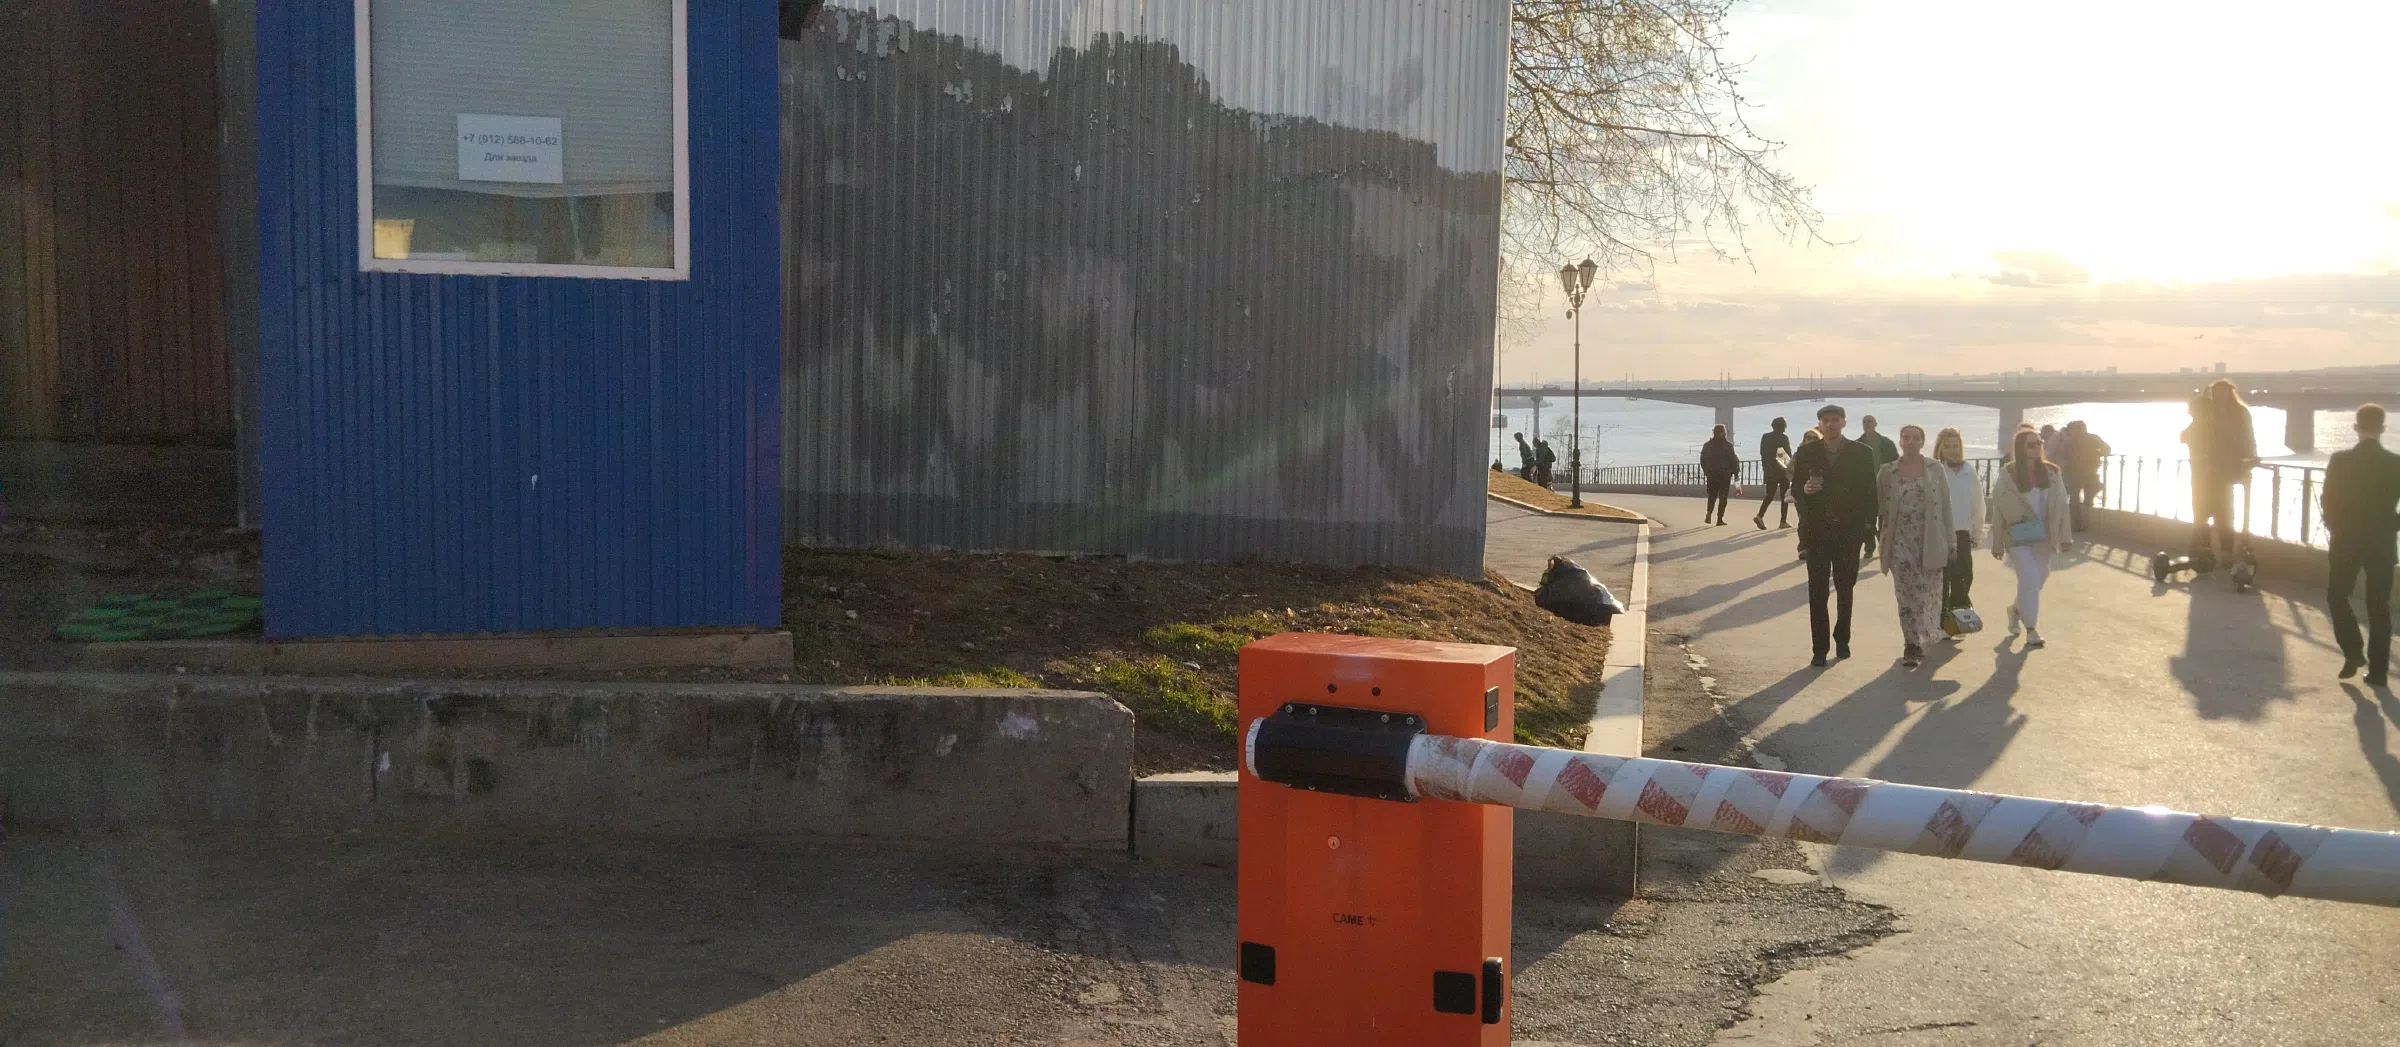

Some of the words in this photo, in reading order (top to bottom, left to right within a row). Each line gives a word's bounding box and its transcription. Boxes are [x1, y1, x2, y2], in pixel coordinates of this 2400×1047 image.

[463, 133, 475, 143] +7
[478, 134, 505, 146] (912)
[484, 152, 504, 162] Для
[1332, 912, 1364, 926] CAME
